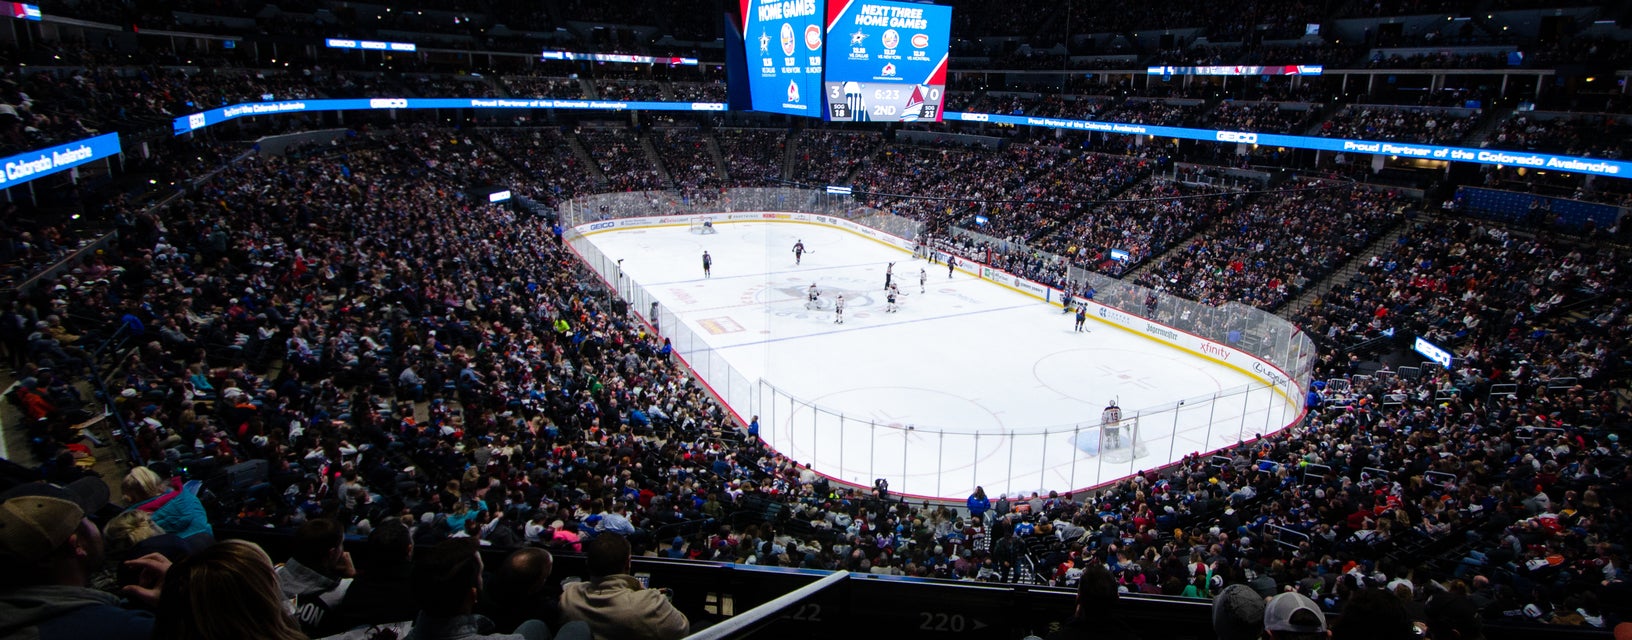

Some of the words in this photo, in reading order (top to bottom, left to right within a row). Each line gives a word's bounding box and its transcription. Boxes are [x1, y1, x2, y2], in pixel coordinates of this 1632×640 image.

[758, 6, 782, 21] HOME
[783, 0, 816, 18] GAMES
[861, 4, 890, 16] NEXT
[891, 7, 923, 18] THREE
[855, 15, 888, 27] HOME
[890, 17, 927, 29] GAMES
[831, 86, 840, 98] 3
[875, 89, 899, 100] 6:23
[930, 89, 939, 100] 0
[370, 98, 407, 108] GEICO
[874, 106, 896, 116] 2ND
[961, 113, 989, 121] GEICO
[1045, 119, 1066, 127] Partner
[1085, 122, 1112, 131] Colorado
[1113, 124, 1146, 133] Avalanche
[1216, 130, 1257, 143] GEICO
[6, 155, 52, 180] Colorado
[53, 145, 92, 167] Avalanche
[1344, 141, 1380, 152] Proud
[1381, 144, 1430, 157] Partner
[1434, 148, 1449, 157] of
[1451, 150, 1474, 160] the
[1478, 151, 1544, 166] Colorado
[1546, 157, 1619, 174] Avalanche
[591, 222, 614, 230] GEICO
[1200, 342, 1231, 360] xfinity
[1415, 337, 1451, 367] GEICO
[1263, 369, 1287, 387] LEXUS
[782, 603, 822, 622] 22
[919, 611, 965, 632] 220
